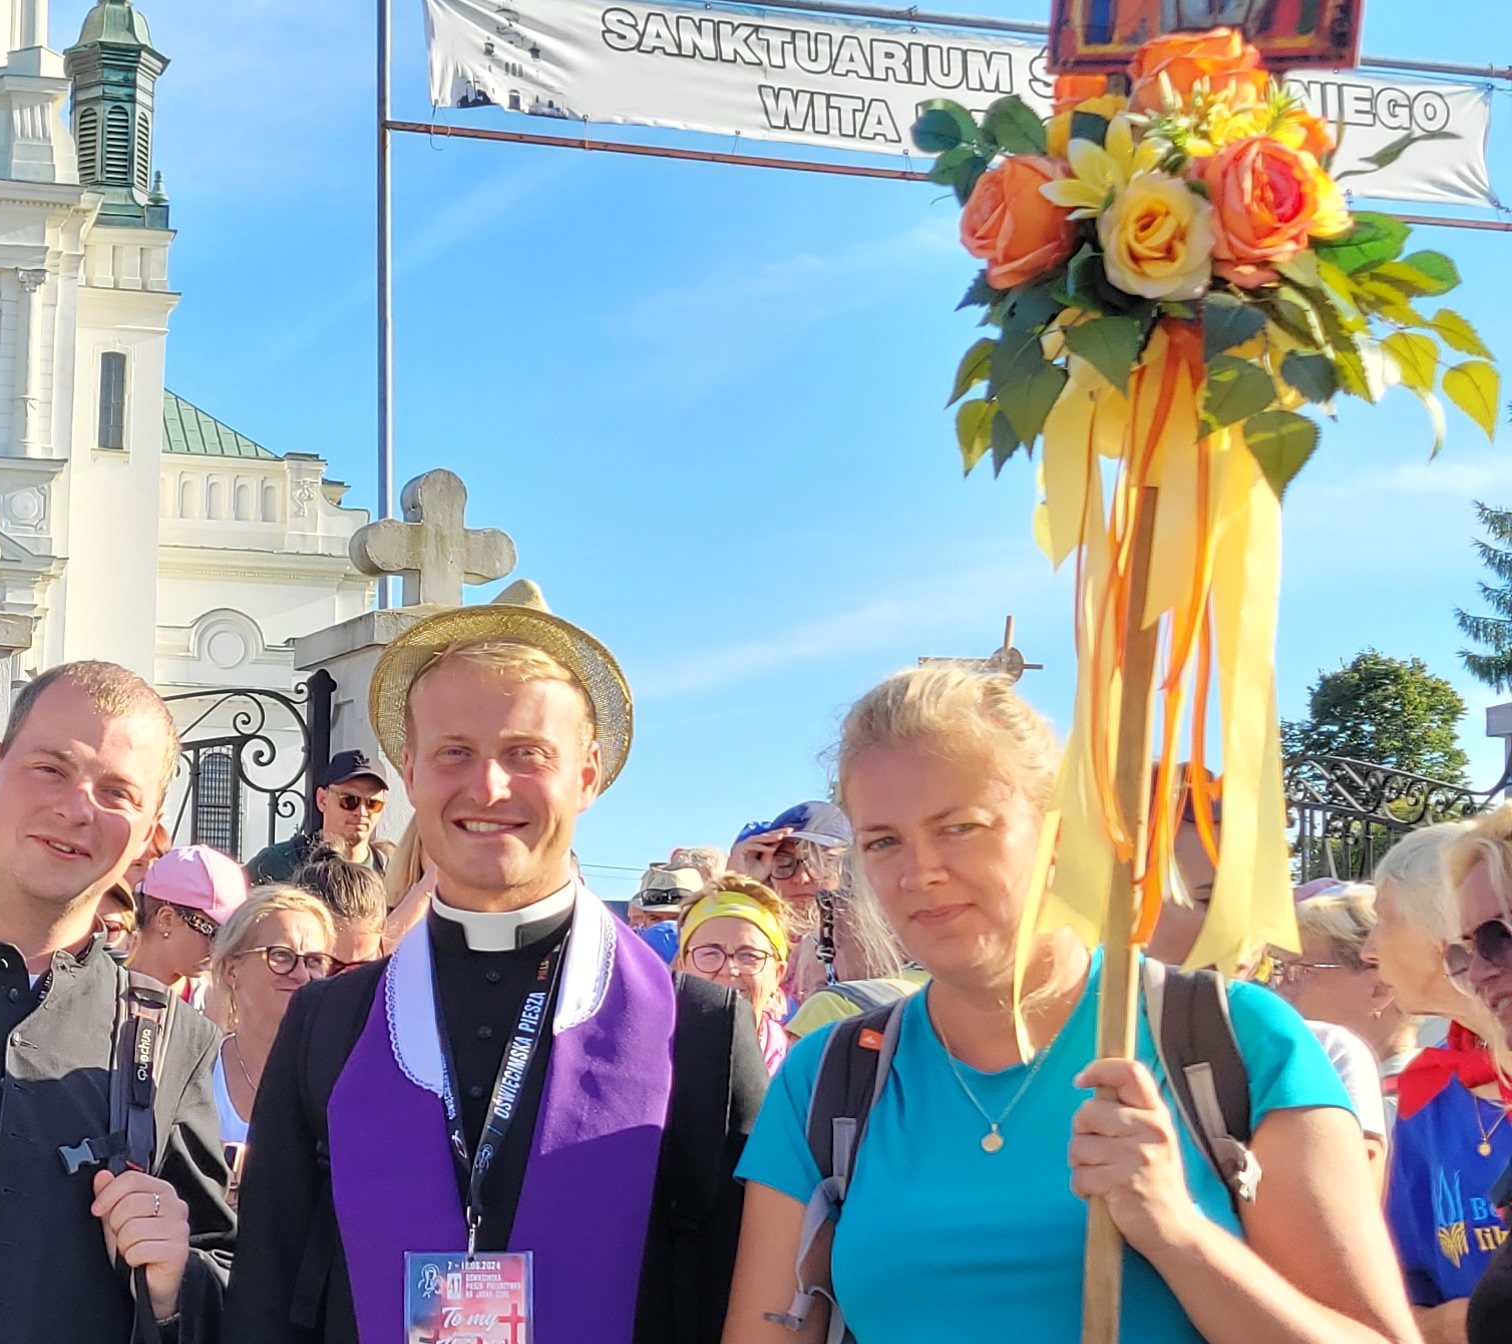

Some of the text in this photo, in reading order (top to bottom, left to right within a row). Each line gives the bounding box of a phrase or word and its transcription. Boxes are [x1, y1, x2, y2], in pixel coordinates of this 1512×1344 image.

[600, 6, 1013, 94] SANKTUARIUM
[1286, 77, 1451, 134] NIEGO
[758, 84, 902, 144] WITA
[493, 1037, 534, 1120] OŚWIĘCIMSKA
[518, 990, 547, 1035] PIESZA
[441, 1307, 499, 1332] To my
